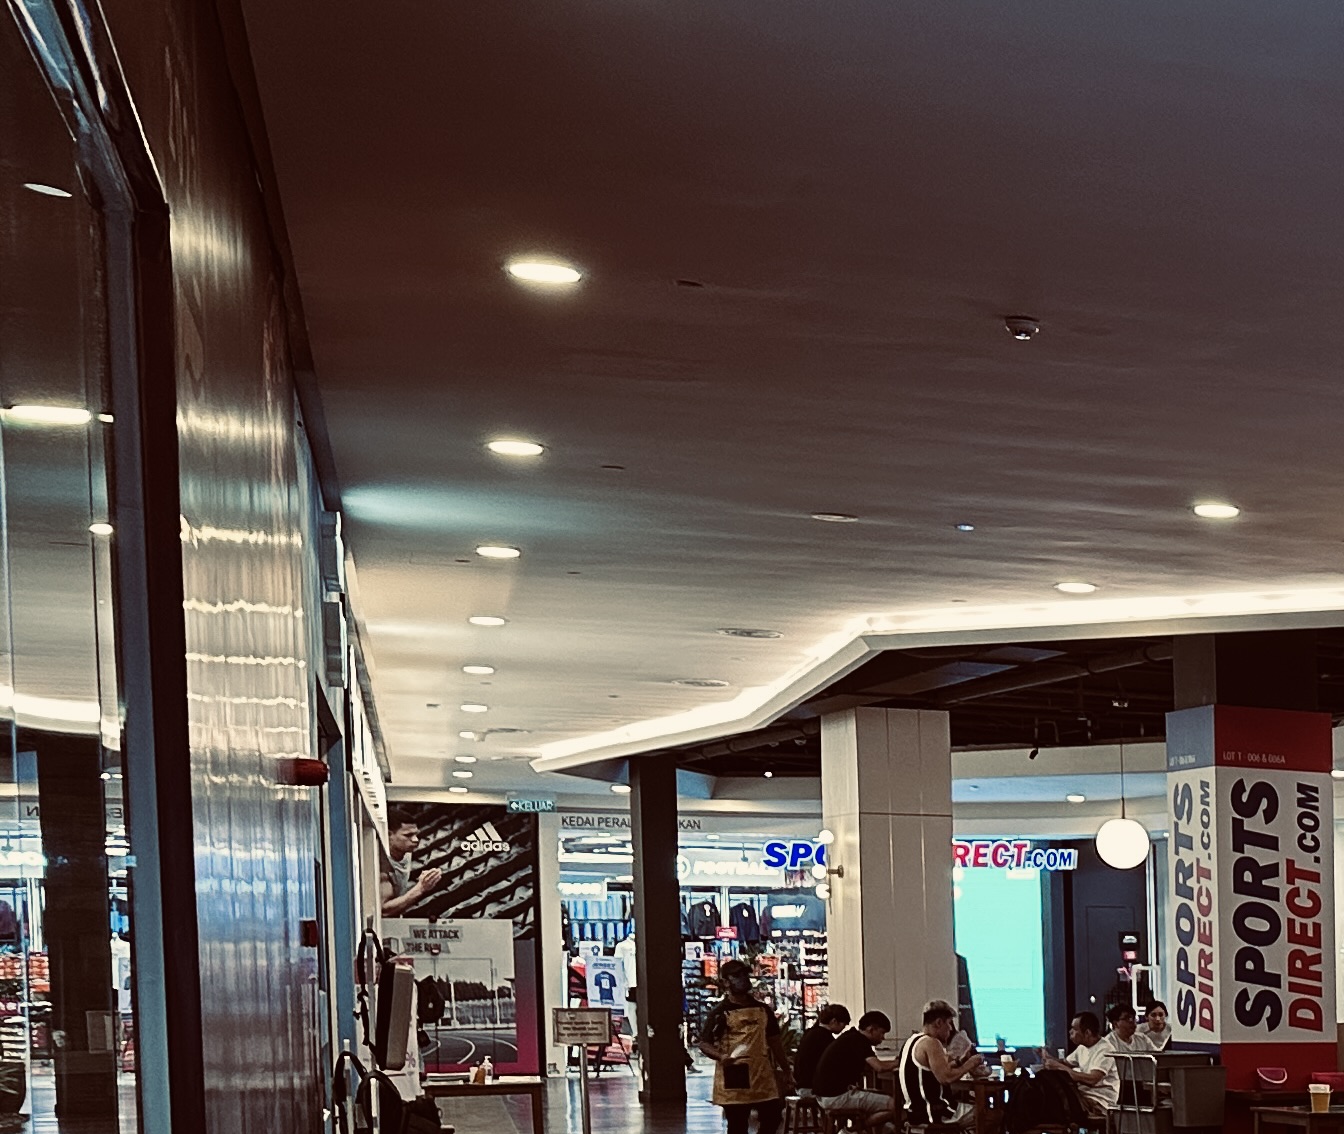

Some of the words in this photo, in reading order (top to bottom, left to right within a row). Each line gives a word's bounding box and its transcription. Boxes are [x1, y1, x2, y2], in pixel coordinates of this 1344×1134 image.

[1222, 751, 1235, 761] LOT
[517, 800, 554, 811] KELUAR
[561, 816, 595, 828] KEDAI
[597, 816, 632, 828] PERAL
[678, 819, 701, 830] KAN
[460, 838, 511, 852] adidas
[952, 840, 1078, 871] RECT.COM
[1173, 781, 1197, 1032] SPORTS
[1196, 779, 1215, 1033] DIRECT.COM
[1230, 777, 1283, 1033] SPORTS
[1285, 781, 1324, 1033] DIRECT.COM
[412, 928, 427, 940] WE
[428, 929, 459, 940] ATTACK
